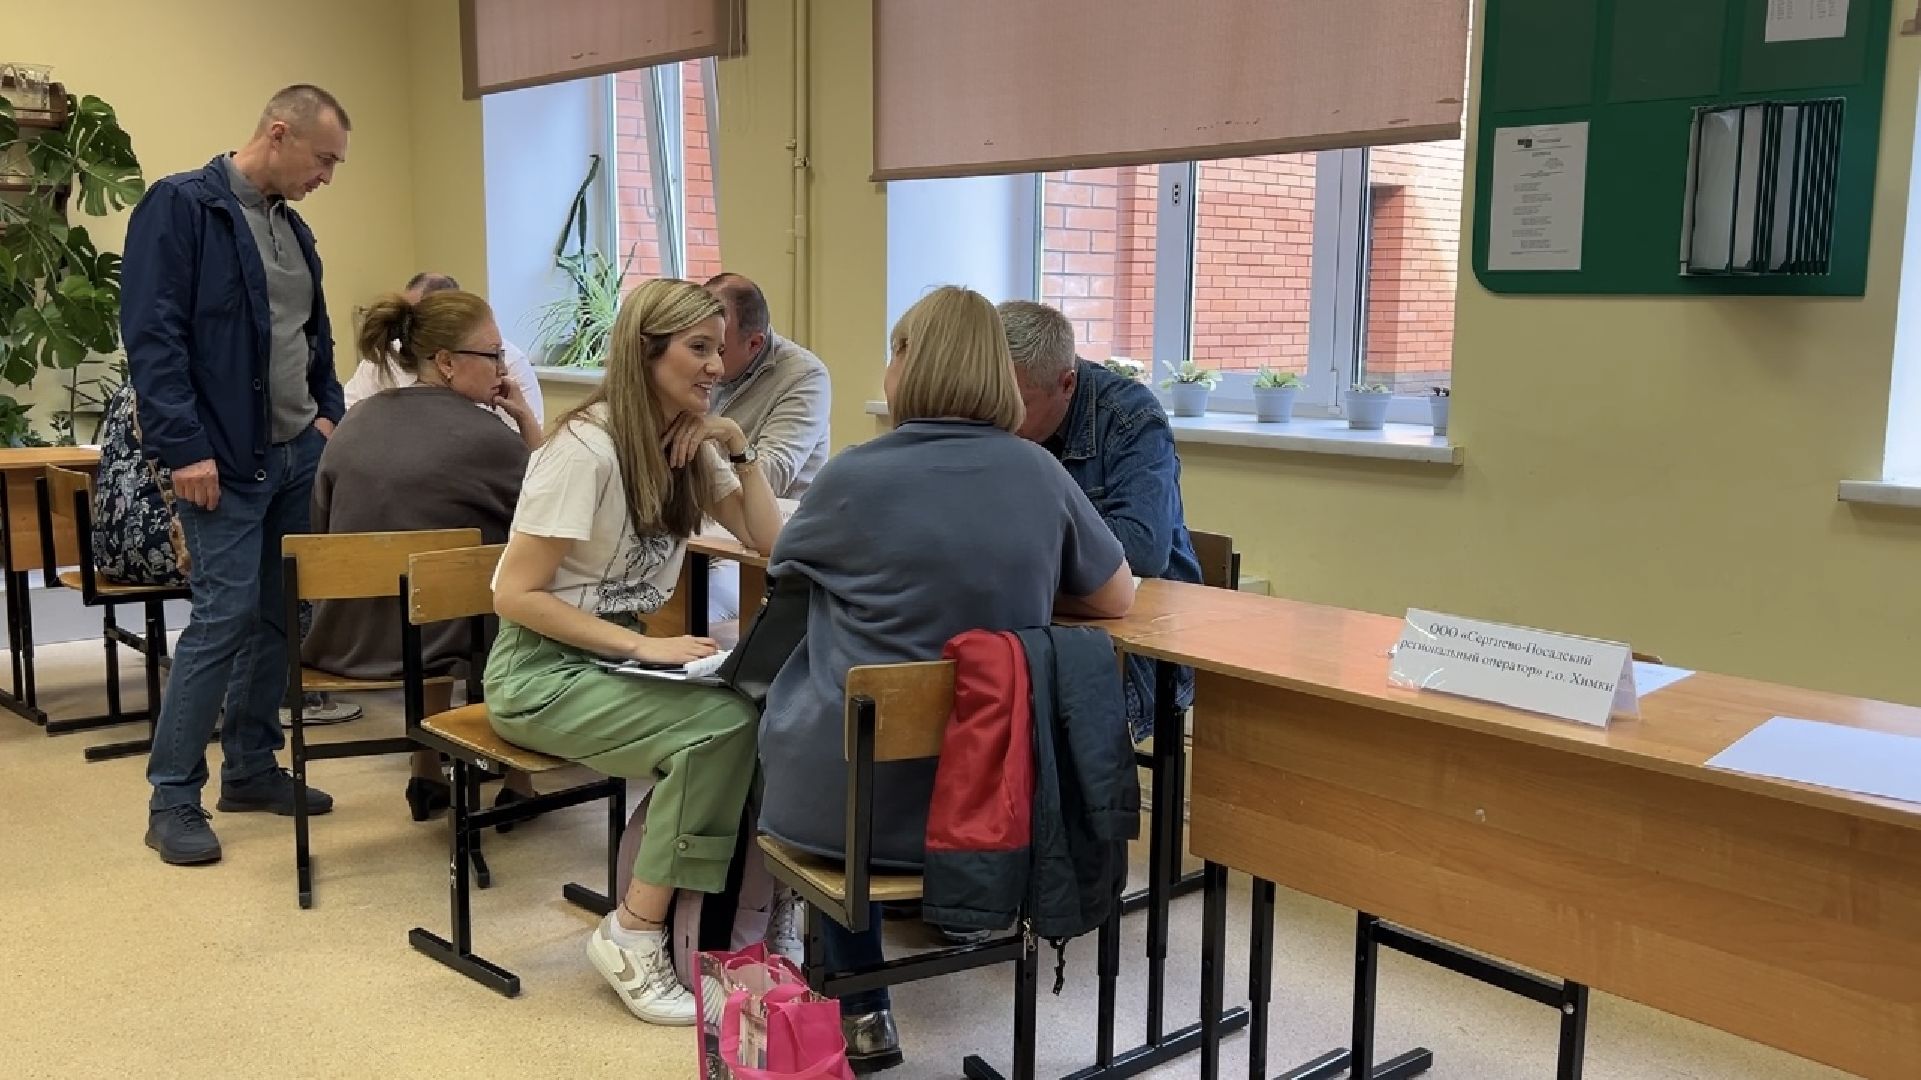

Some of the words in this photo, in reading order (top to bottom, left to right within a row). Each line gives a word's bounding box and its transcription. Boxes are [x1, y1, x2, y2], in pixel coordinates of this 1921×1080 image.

[1429, 623, 1459, 638] ООО
[1400, 639, 1481, 663] региональный
[1569, 672, 1615, 692] Химки
